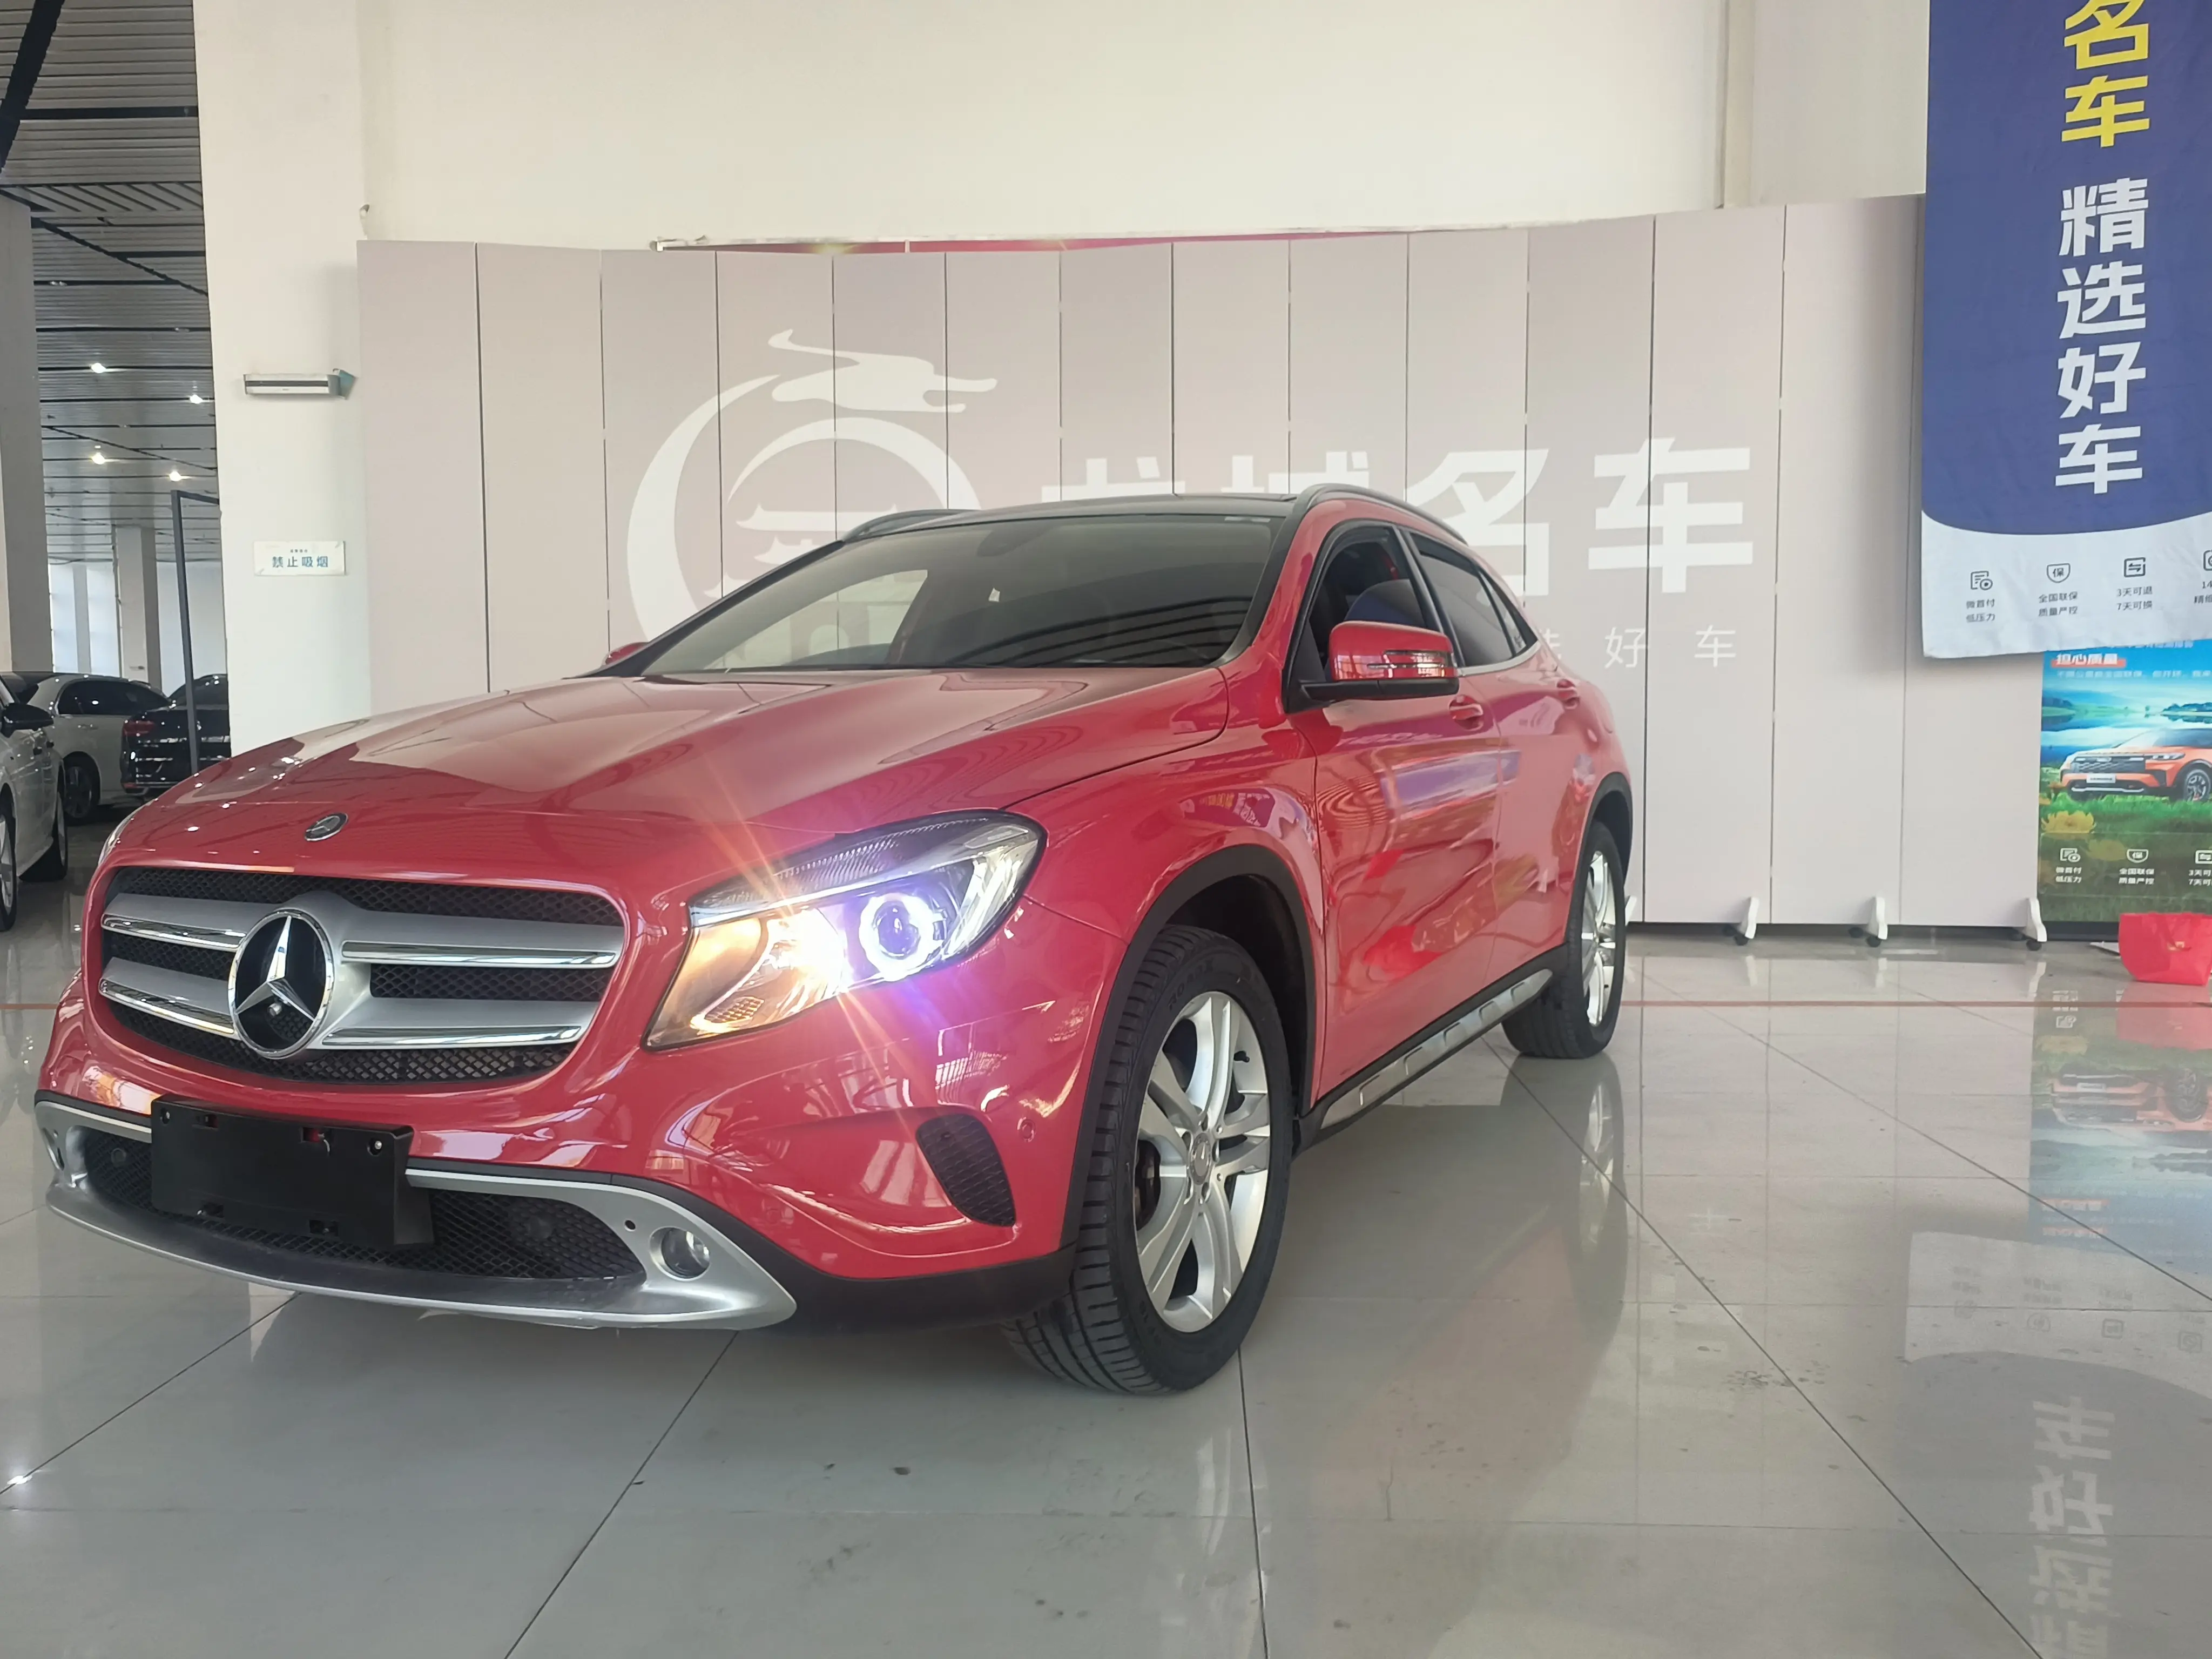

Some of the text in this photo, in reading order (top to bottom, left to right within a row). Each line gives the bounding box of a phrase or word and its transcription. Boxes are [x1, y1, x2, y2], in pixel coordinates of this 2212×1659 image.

[2055, 0, 2149, 494] 名车 精选好车
[272, 556, 328, 568] 禁止吸烟
[2038, 591, 2078, 604] 全国联保
[2188, 878, 2212, 886] 7天可
